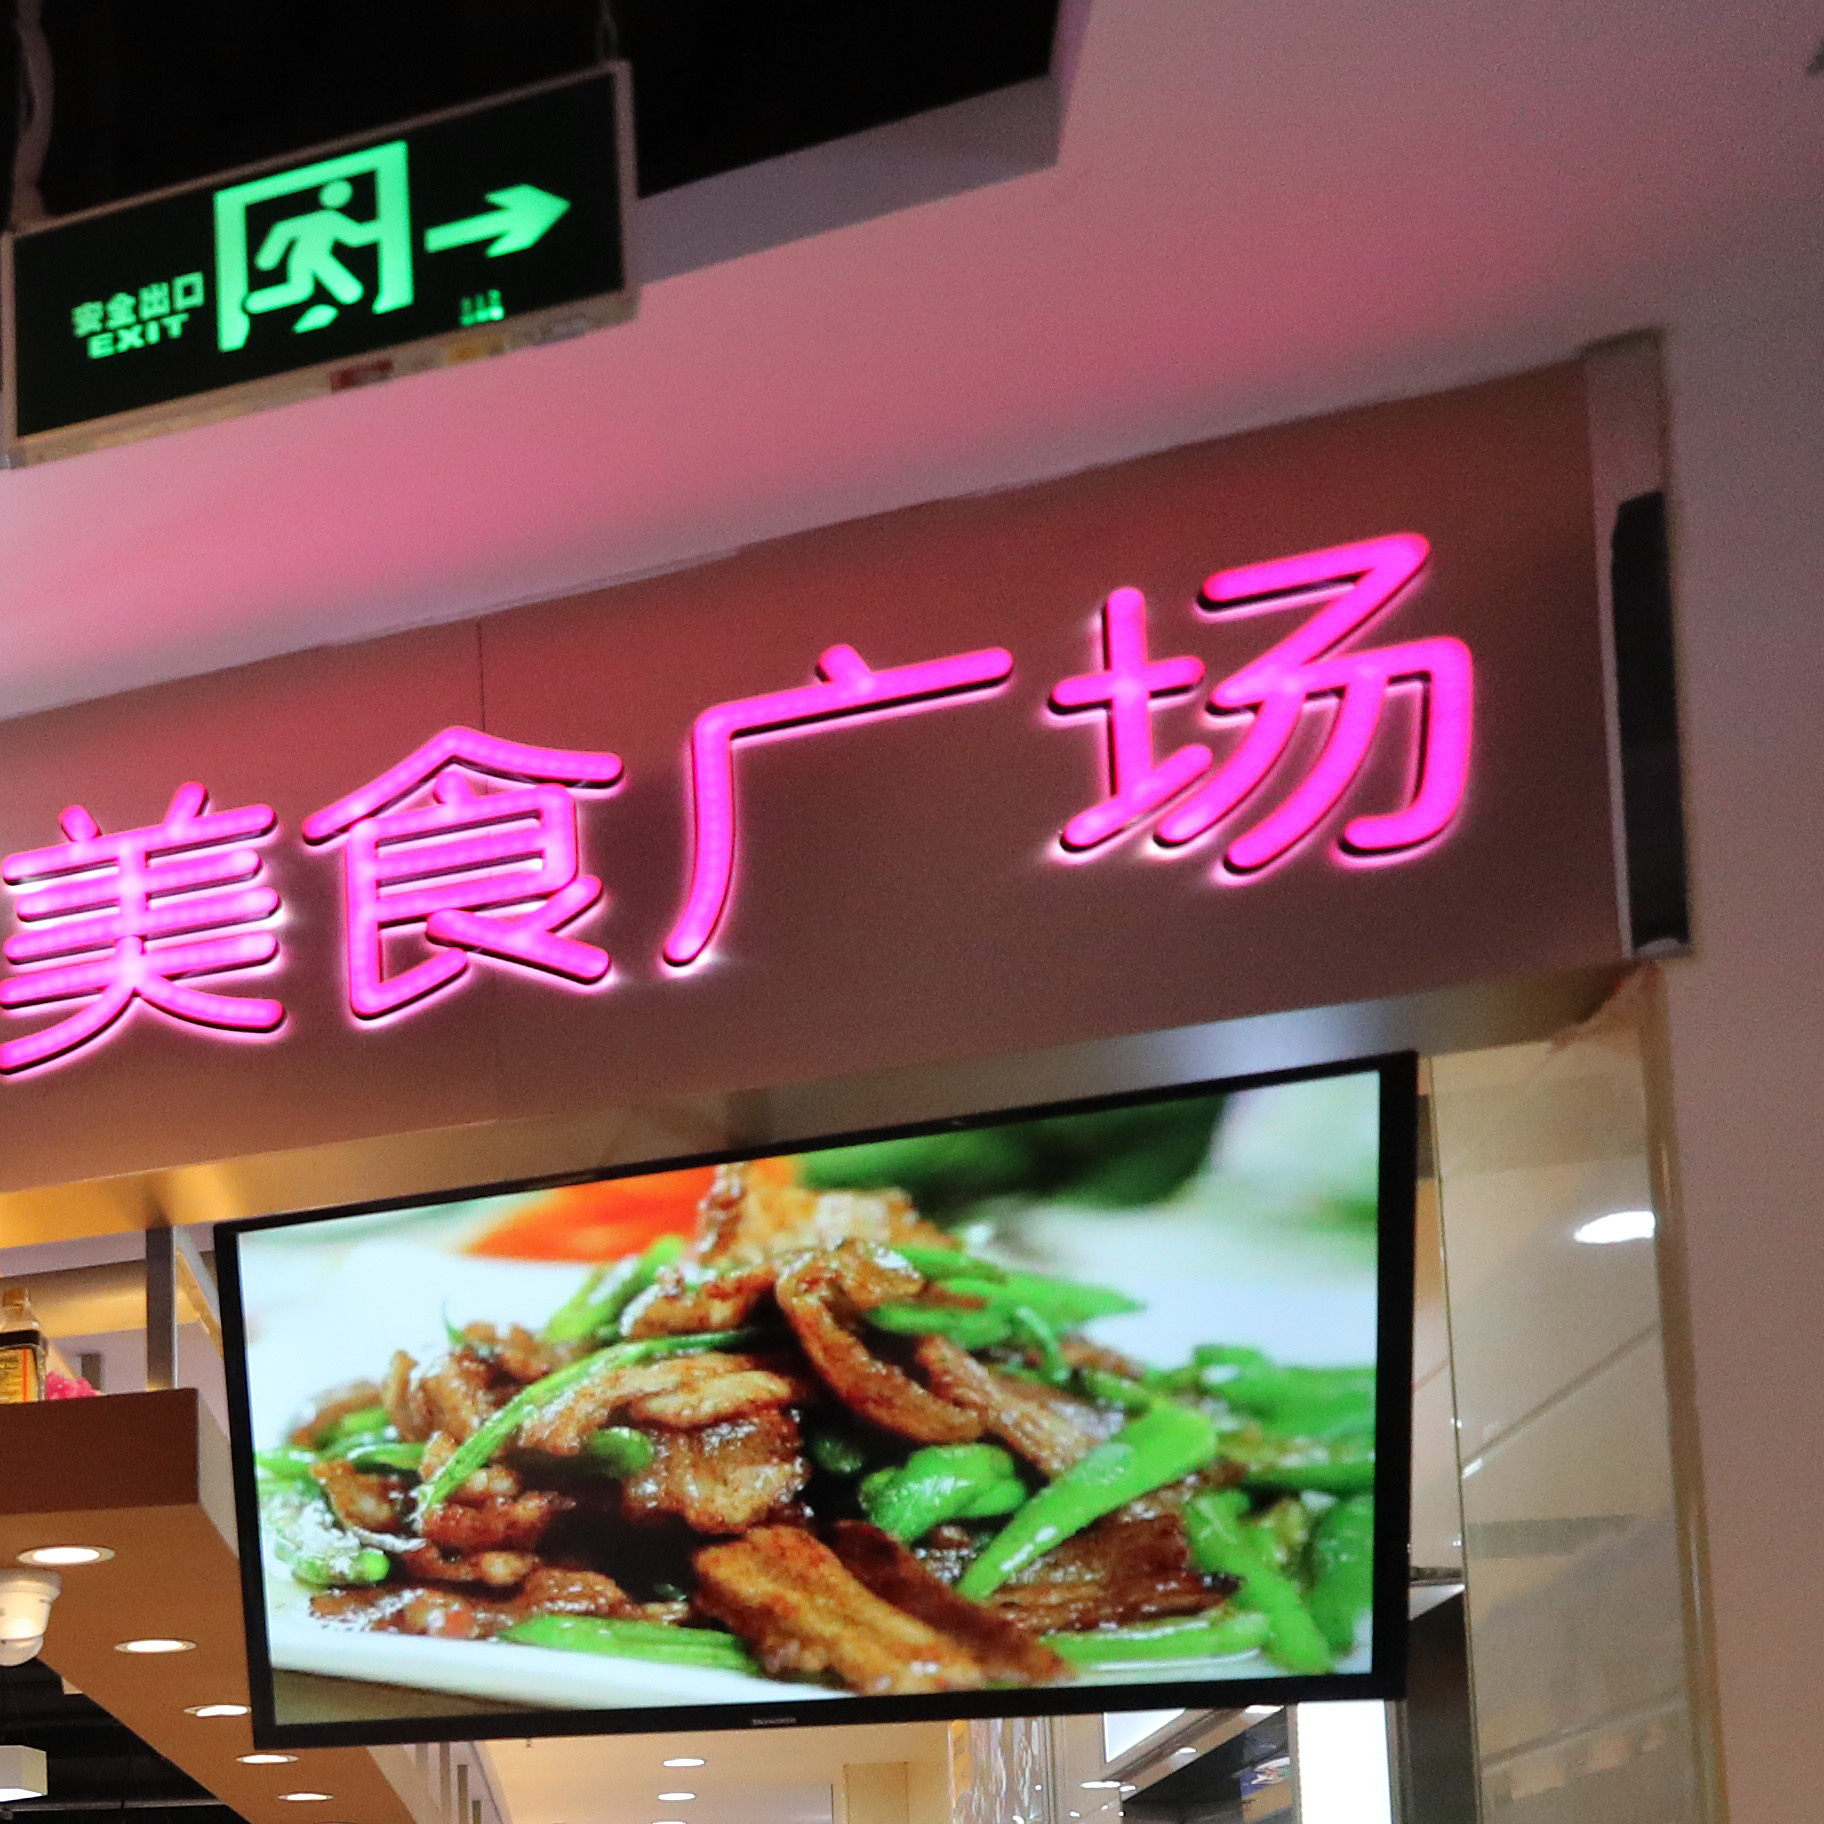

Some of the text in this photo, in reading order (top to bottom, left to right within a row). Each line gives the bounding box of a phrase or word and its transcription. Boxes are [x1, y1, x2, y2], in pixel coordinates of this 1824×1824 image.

[71, 271, 205, 337] 安全出口
[87, 312, 190, 359] EXIT
